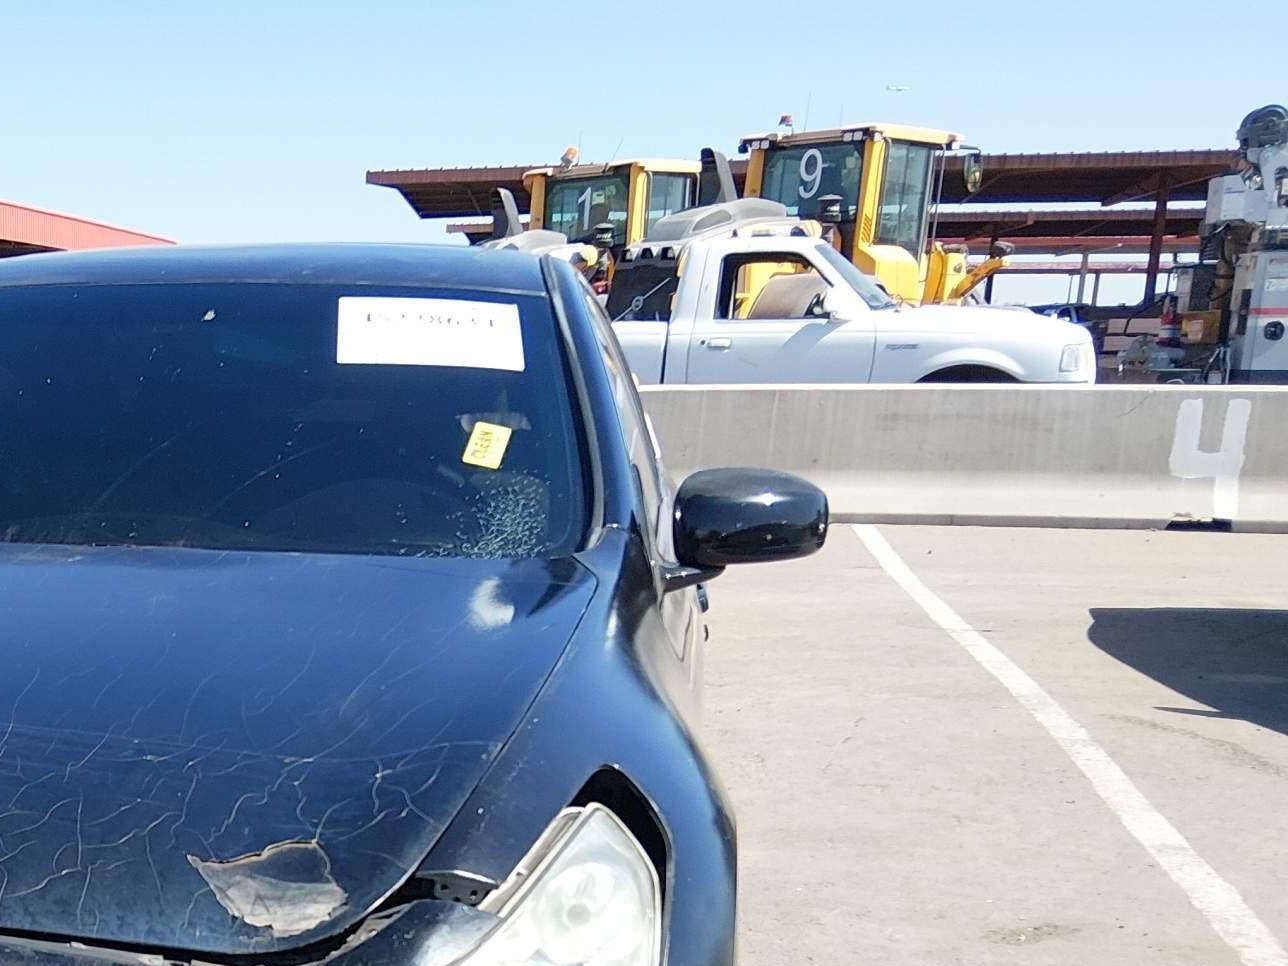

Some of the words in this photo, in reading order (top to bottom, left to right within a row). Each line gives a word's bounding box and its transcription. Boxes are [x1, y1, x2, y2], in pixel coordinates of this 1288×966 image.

[799, 148, 822, 199] 9
[577, 186, 592, 231] 1
[1168, 398, 1252, 520] 4
